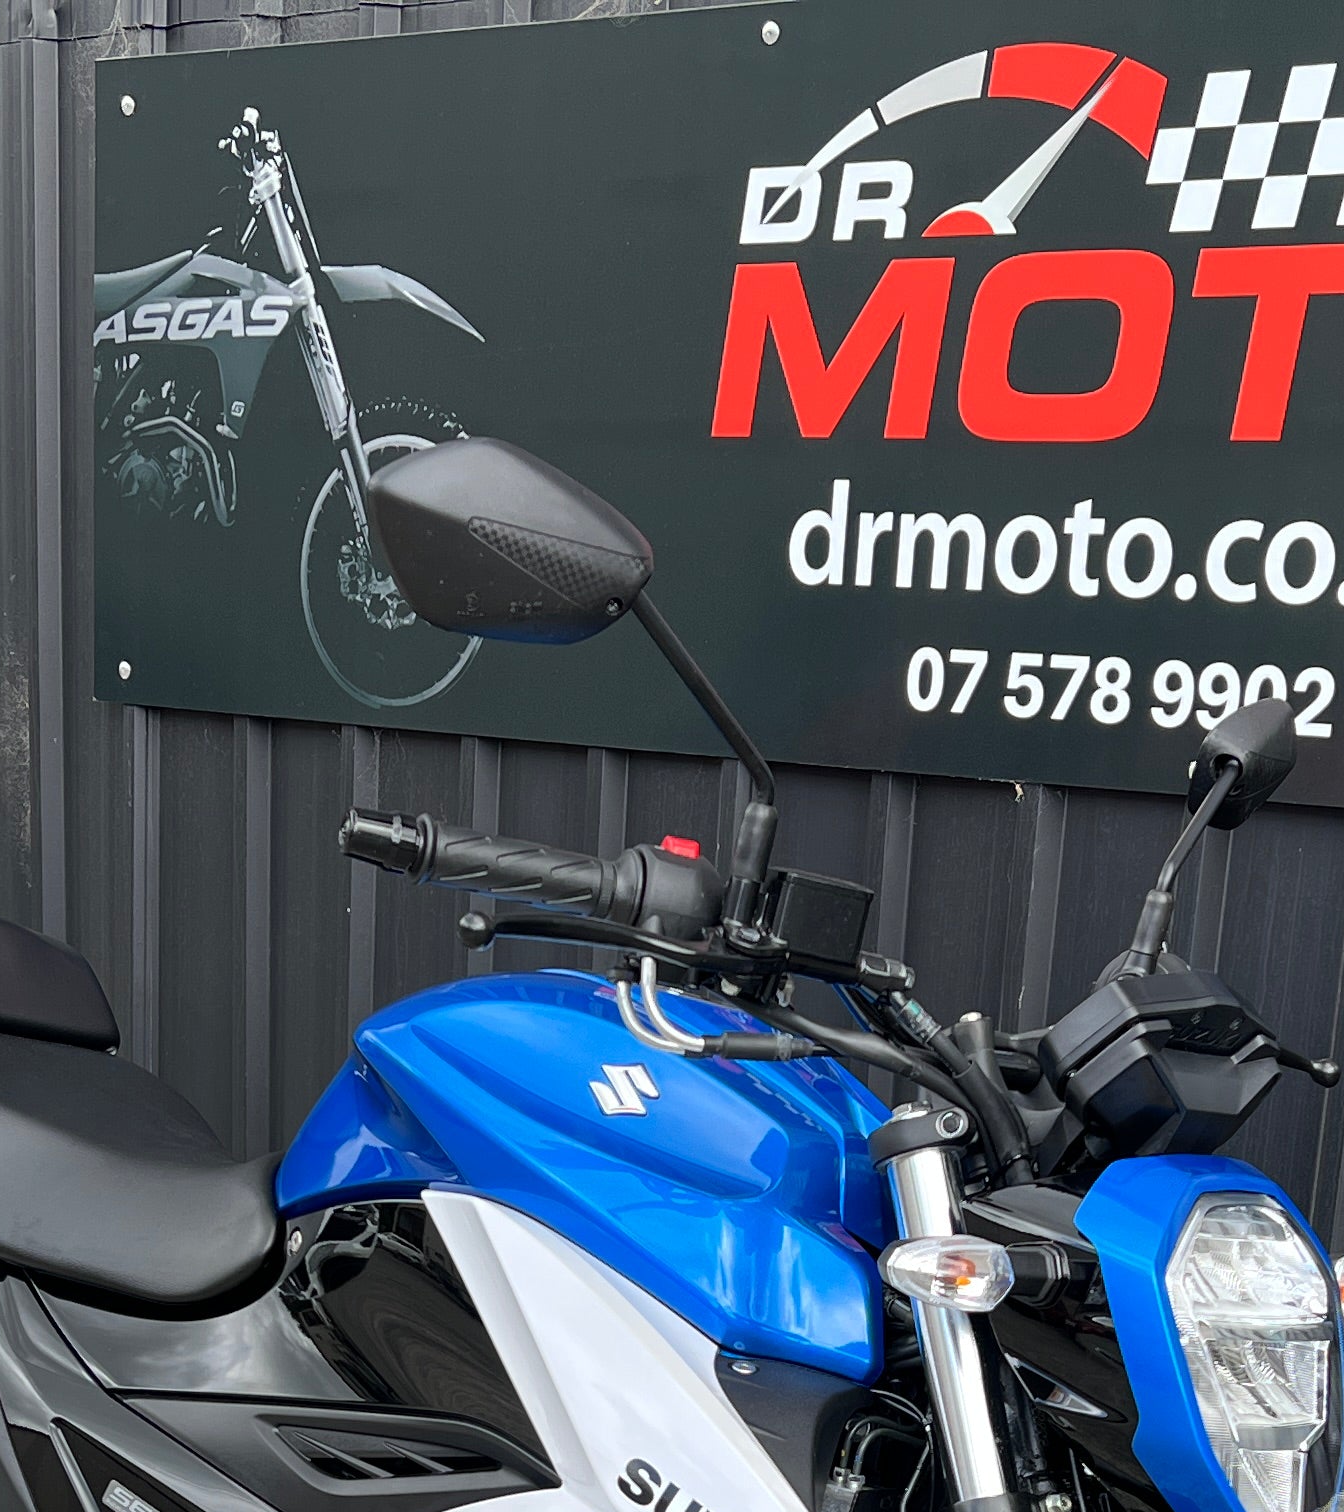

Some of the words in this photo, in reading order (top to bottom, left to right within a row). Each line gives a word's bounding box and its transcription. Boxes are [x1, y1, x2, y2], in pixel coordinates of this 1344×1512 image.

[739, 160, 914, 245] DR
[906, 646, 989, 714] 07
[1003, 651, 1132, 725] 578
[1150, 658, 1336, 739] 9902
